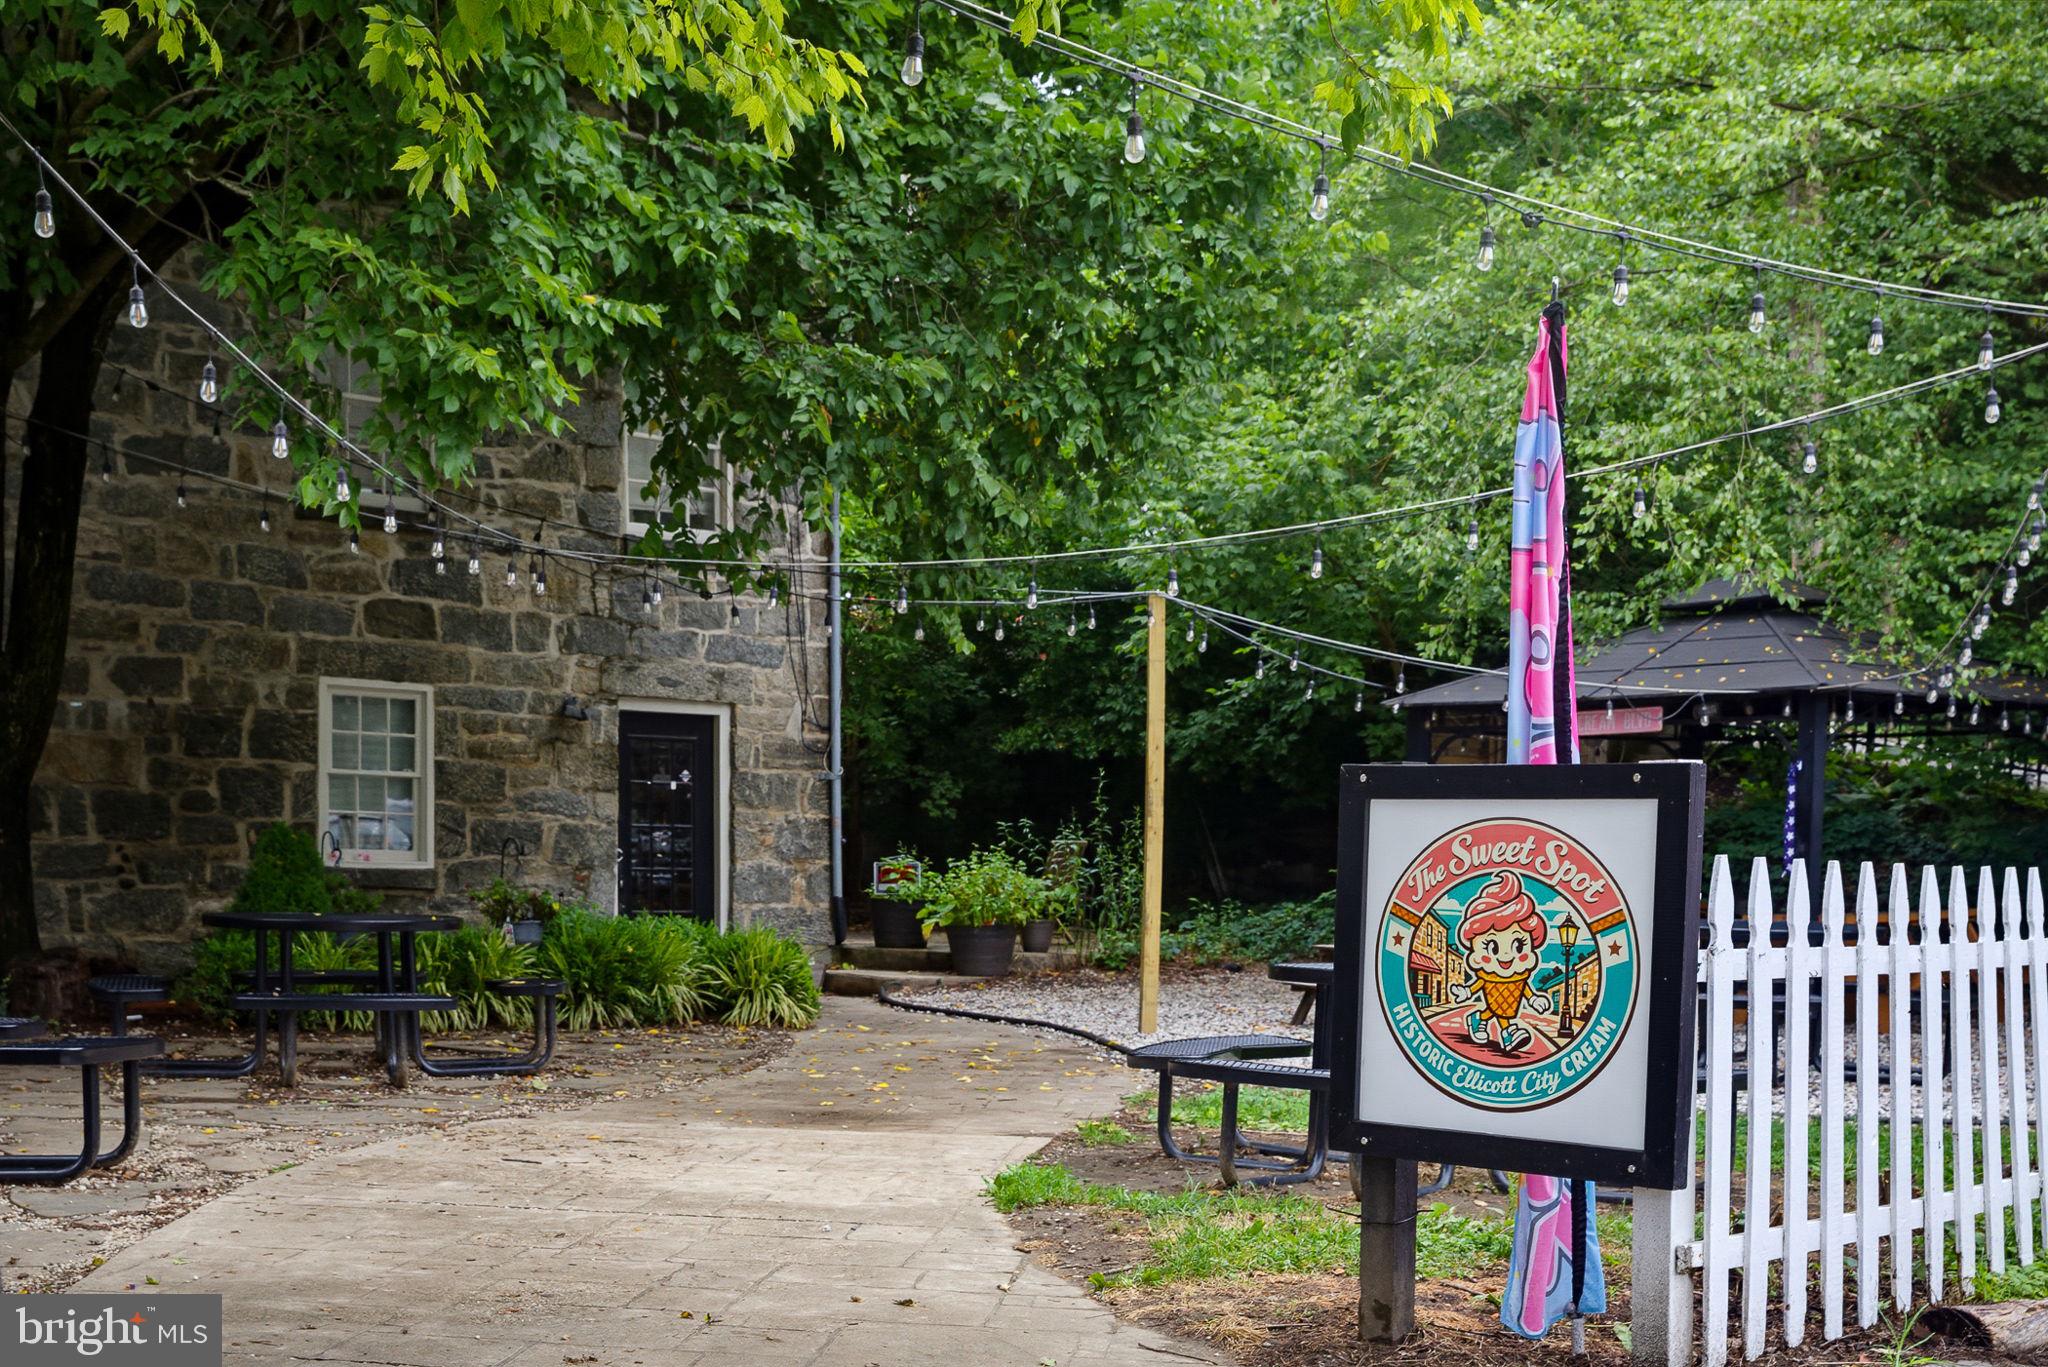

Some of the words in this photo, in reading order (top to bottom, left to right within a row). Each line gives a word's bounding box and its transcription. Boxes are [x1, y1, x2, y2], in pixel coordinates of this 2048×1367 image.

[1408, 857, 1448, 902] The
[1449, 834, 1536, 876] Sweet
[1535, 840, 1608, 903] Spot
[1391, 1002, 1453, 1077] HISTORIC
[1452, 1065, 1517, 1095] Ellicott
[1521, 1071, 1563, 1096] City
[1560, 1016, 1617, 1078] CREAM
